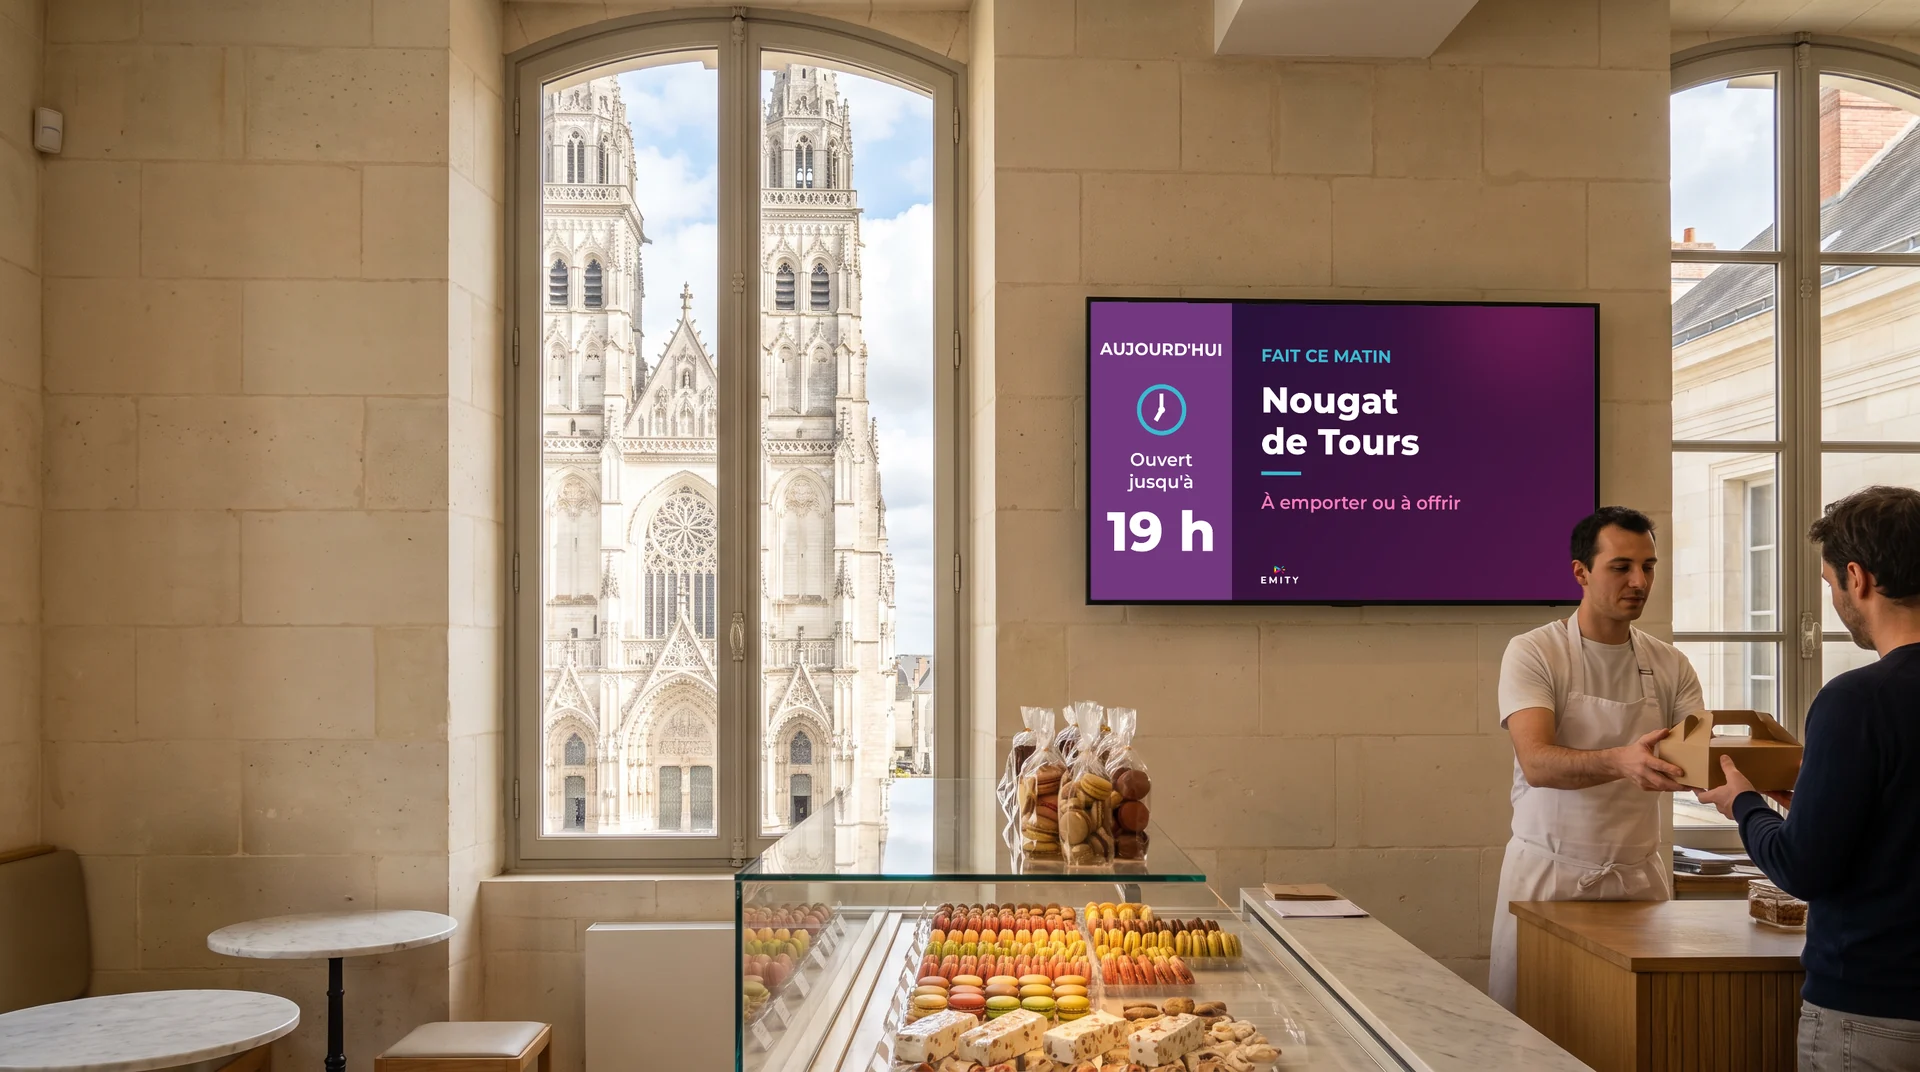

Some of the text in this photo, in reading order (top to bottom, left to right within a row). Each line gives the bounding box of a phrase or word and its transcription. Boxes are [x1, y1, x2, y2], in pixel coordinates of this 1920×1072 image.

[1099, 342, 1222, 357] AUJOURD'HUI
[1262, 348, 1391, 364] FAIT CE MATIN
[1262, 386, 1399, 422] Nougat
[1261, 426, 1420, 456] de Tours
[1130, 452, 1193, 467] Ouvert
[1127, 473, 1193, 492] jusqu'à
[1261, 491, 1461, 514] À emporter ou à offrir
[1106, 509, 1214, 553] 19 h
[1260, 575, 1299, 585] EMITY
